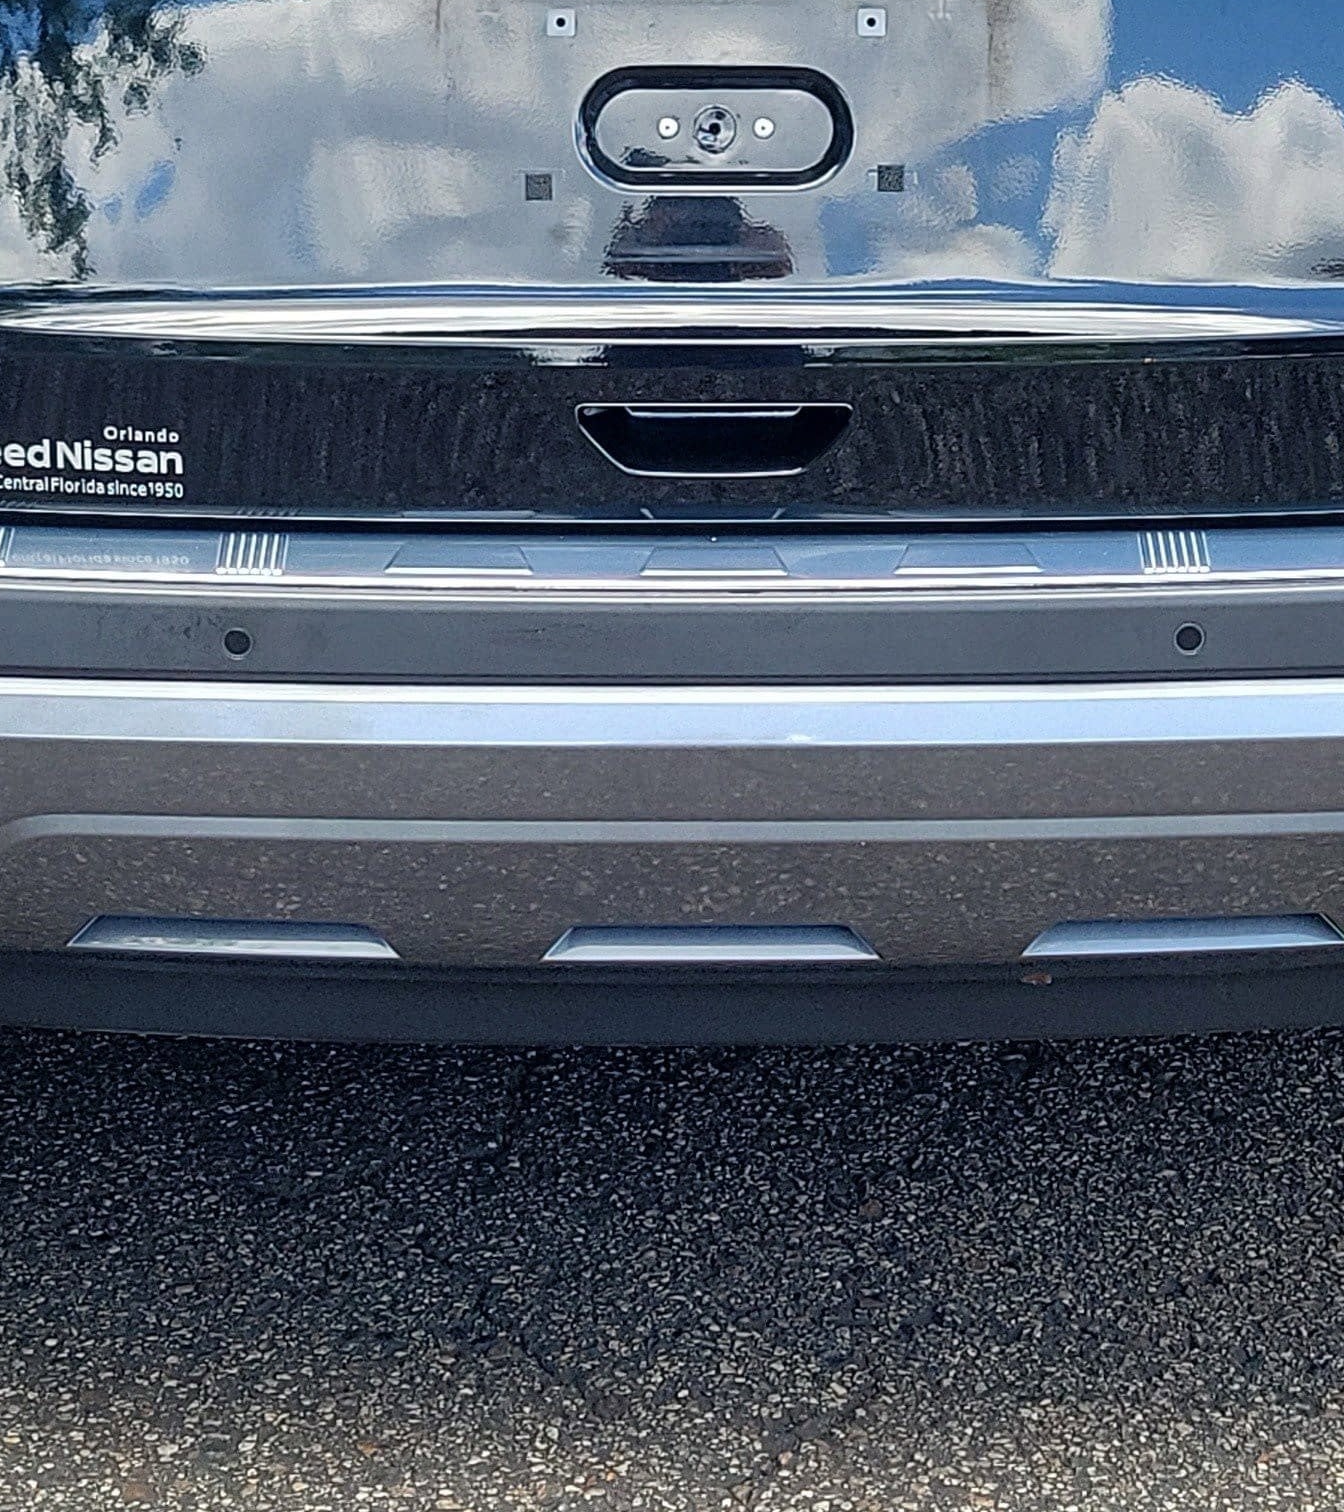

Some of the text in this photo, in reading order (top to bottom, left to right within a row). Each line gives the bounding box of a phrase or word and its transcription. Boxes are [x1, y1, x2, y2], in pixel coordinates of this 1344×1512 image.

[103, 426, 180, 443] Orlando
[56, 440, 183, 474] Nissan
[51, 477, 105, 495] Florida
[107, 480, 147, 496] since
[148, 482, 184, 498] 1950
